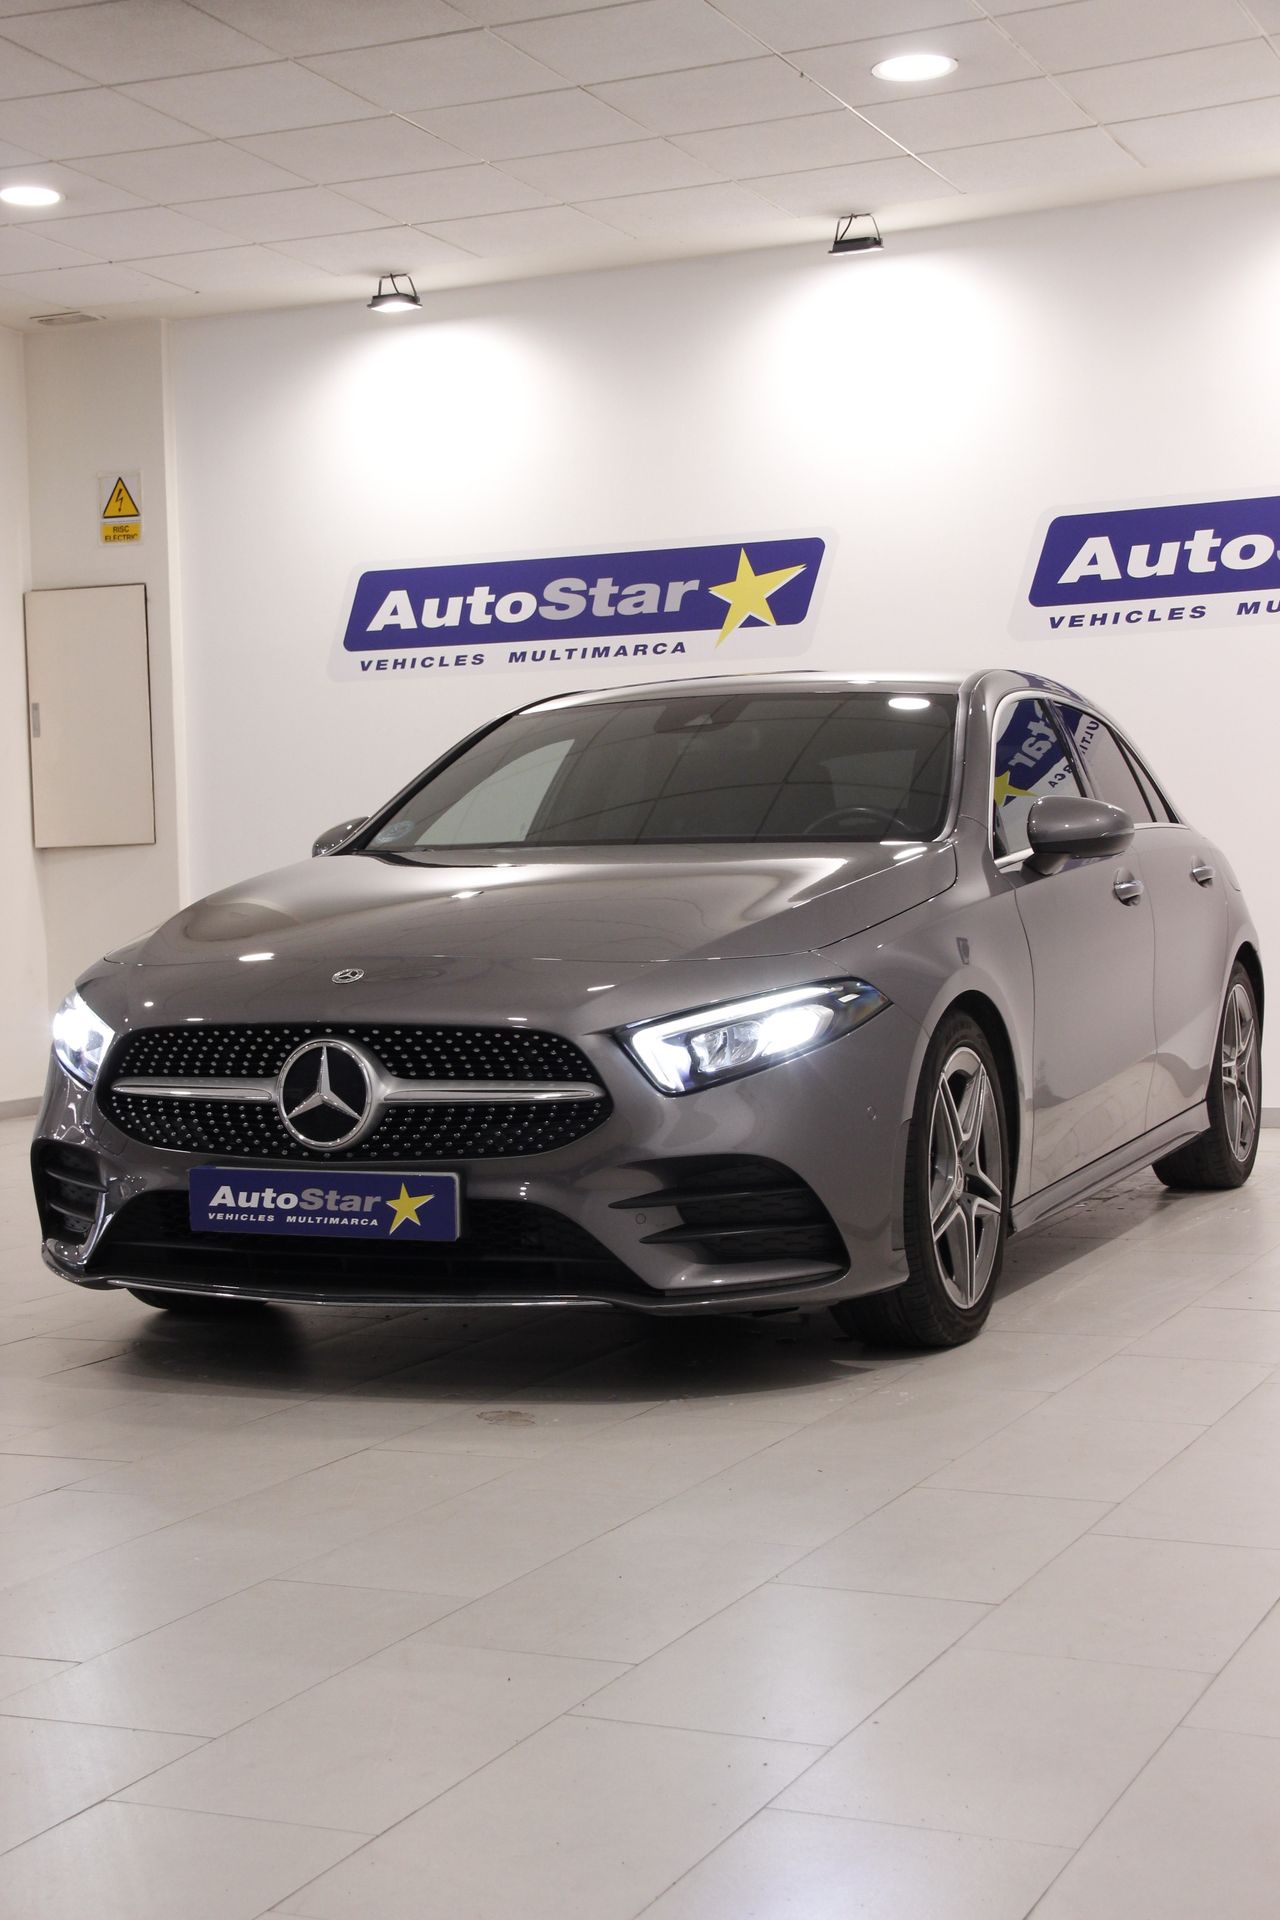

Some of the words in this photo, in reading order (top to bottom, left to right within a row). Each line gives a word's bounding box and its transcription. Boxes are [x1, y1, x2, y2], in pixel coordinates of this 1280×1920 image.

[112, 525, 130, 533] RISC
[1057, 529, 1280, 584] Auto
[365, 578, 700, 632] AutoStar
[1049, 606, 1207, 629] VEHICLES
[360, 653, 486, 671] VEHICLES
[508, 641, 687, 664] MULTIMARCA
[208, 1185, 382, 1213] AutoStar
[207, 1212, 276, 1222] VEHICLES
[286, 1215, 380, 1226] MULTIMARCA
